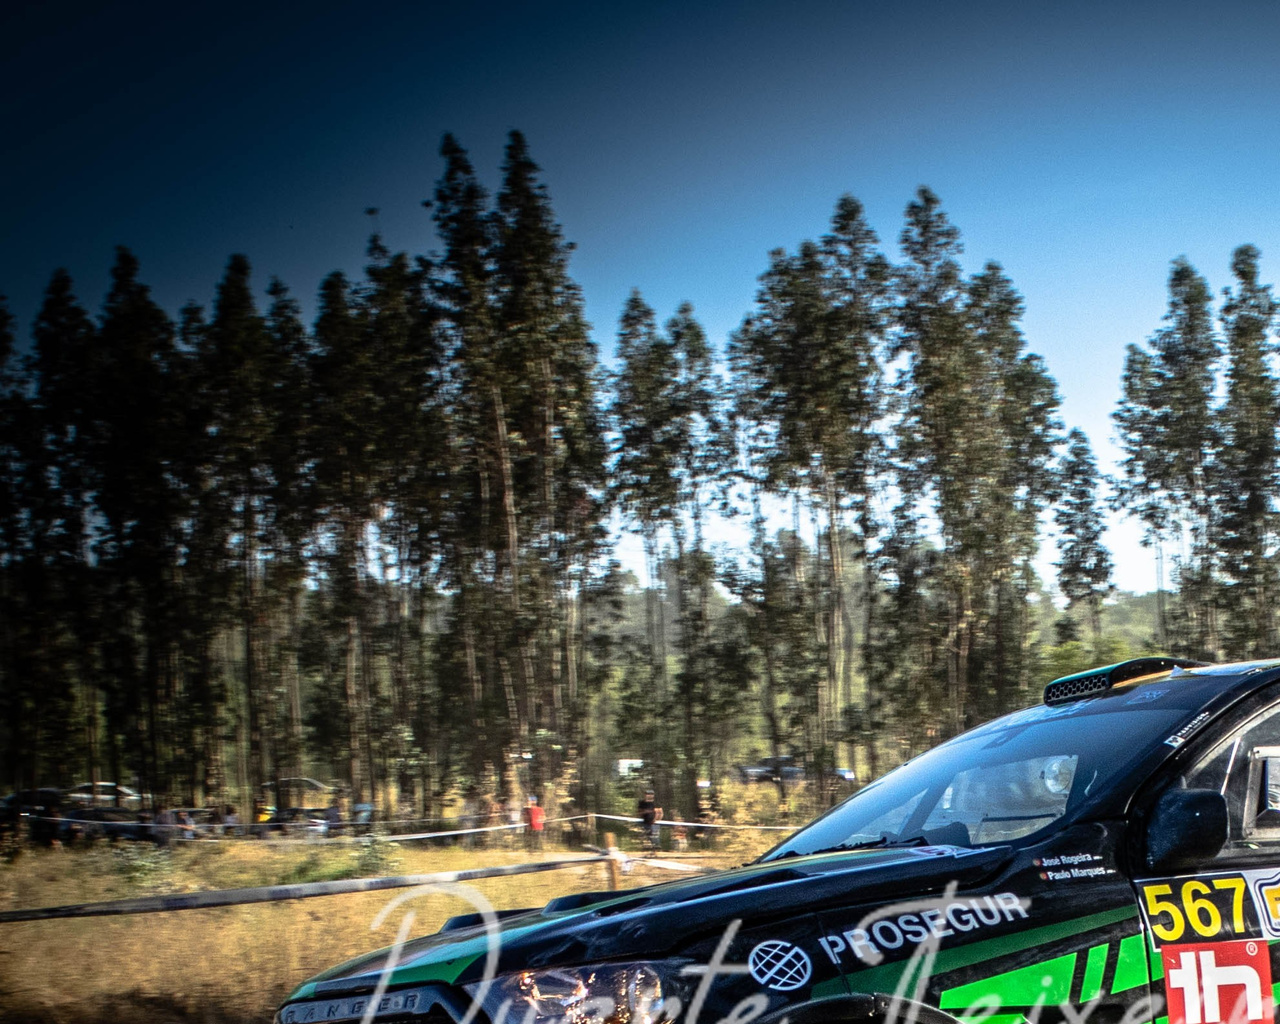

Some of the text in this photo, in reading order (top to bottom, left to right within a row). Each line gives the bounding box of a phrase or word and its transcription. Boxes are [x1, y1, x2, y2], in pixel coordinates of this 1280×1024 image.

[1047, 869, 1071, 880] Paulo
[818, 892, 1030, 965] PROSEGUR
[1143, 877, 1248, 941] 567
[285, 993, 419, 1023] RANGER
